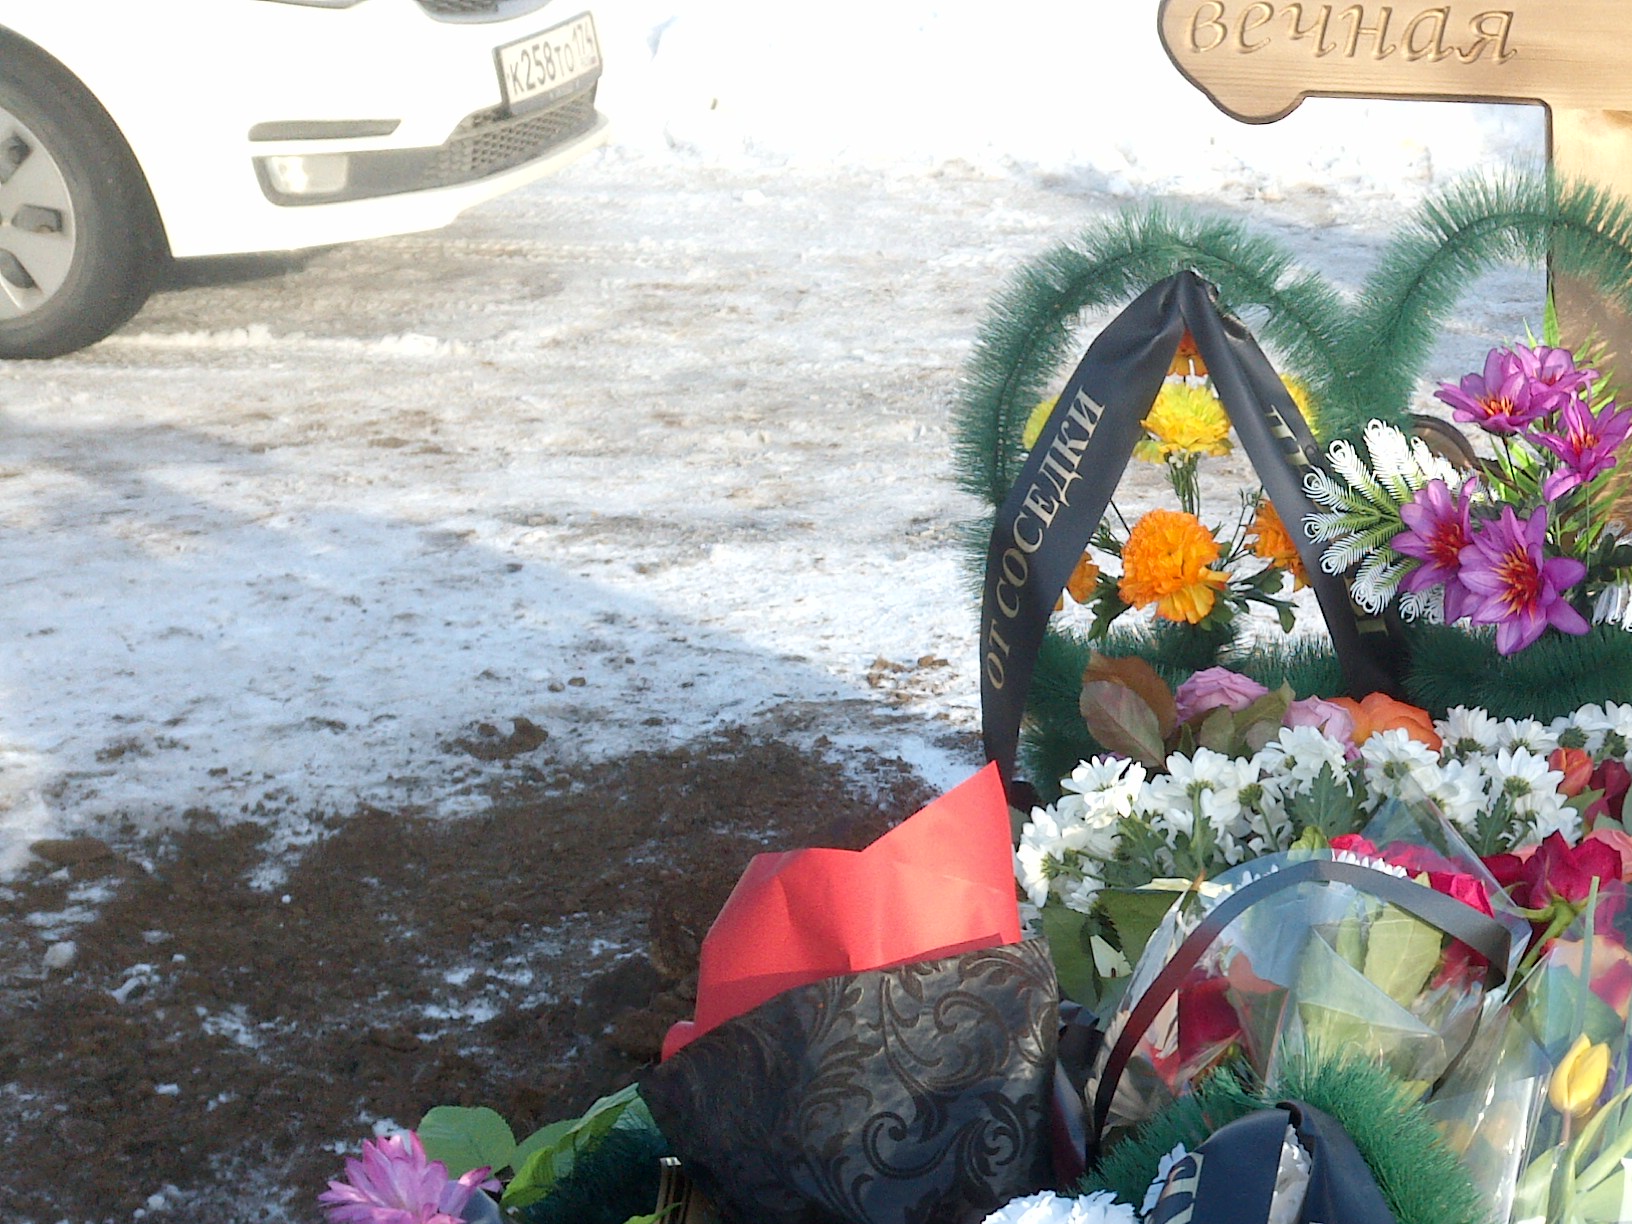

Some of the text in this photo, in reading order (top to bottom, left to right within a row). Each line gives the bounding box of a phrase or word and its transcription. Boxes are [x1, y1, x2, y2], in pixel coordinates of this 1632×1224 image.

[1188, 0, 1518, 64] вечная
[987, 385, 1106, 690] ОТ СОСЕДКИ
